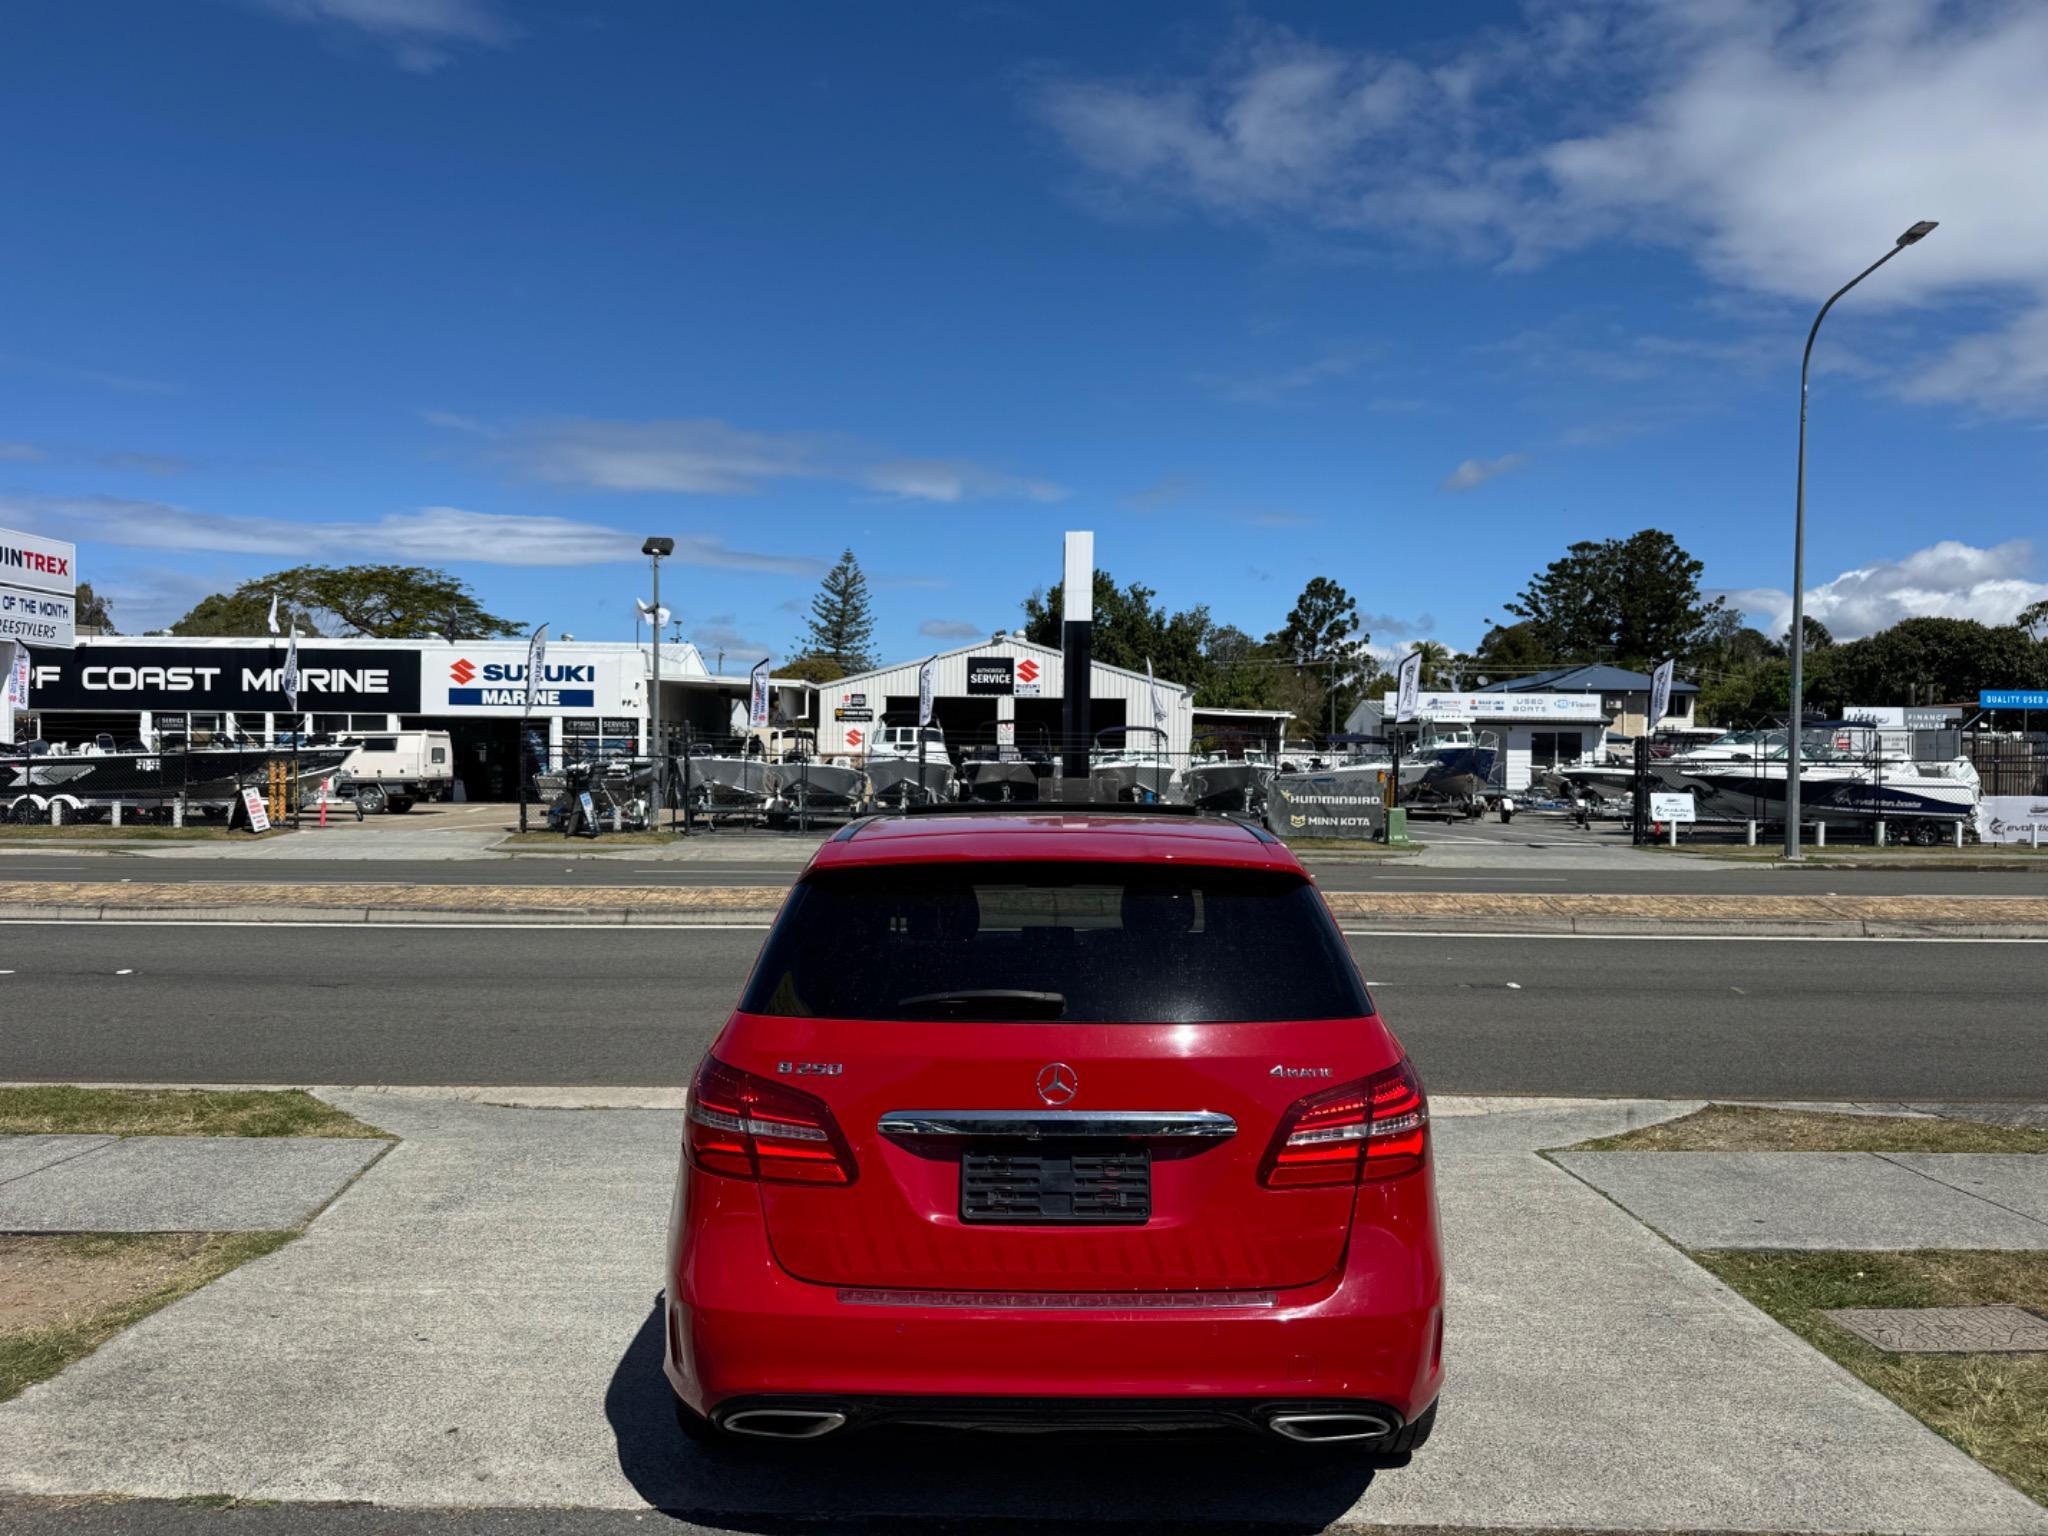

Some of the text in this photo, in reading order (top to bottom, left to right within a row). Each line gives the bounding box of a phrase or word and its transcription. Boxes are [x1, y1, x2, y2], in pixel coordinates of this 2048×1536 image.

[3, 595, 69, 620] OF THE MONTH
[81, 666, 221, 692] COAST
[483, 664, 595, 682] SUUKI
[970, 673, 1012, 684] SERVICE
[481, 689, 560, 705] MARNE
[1986, 695, 2020, 704] QUALITY
[2022, 695, 2043, 704] USED
[1308, 816, 1370, 826] MINN KOTA
[796, 1062, 843, 1077] 250
